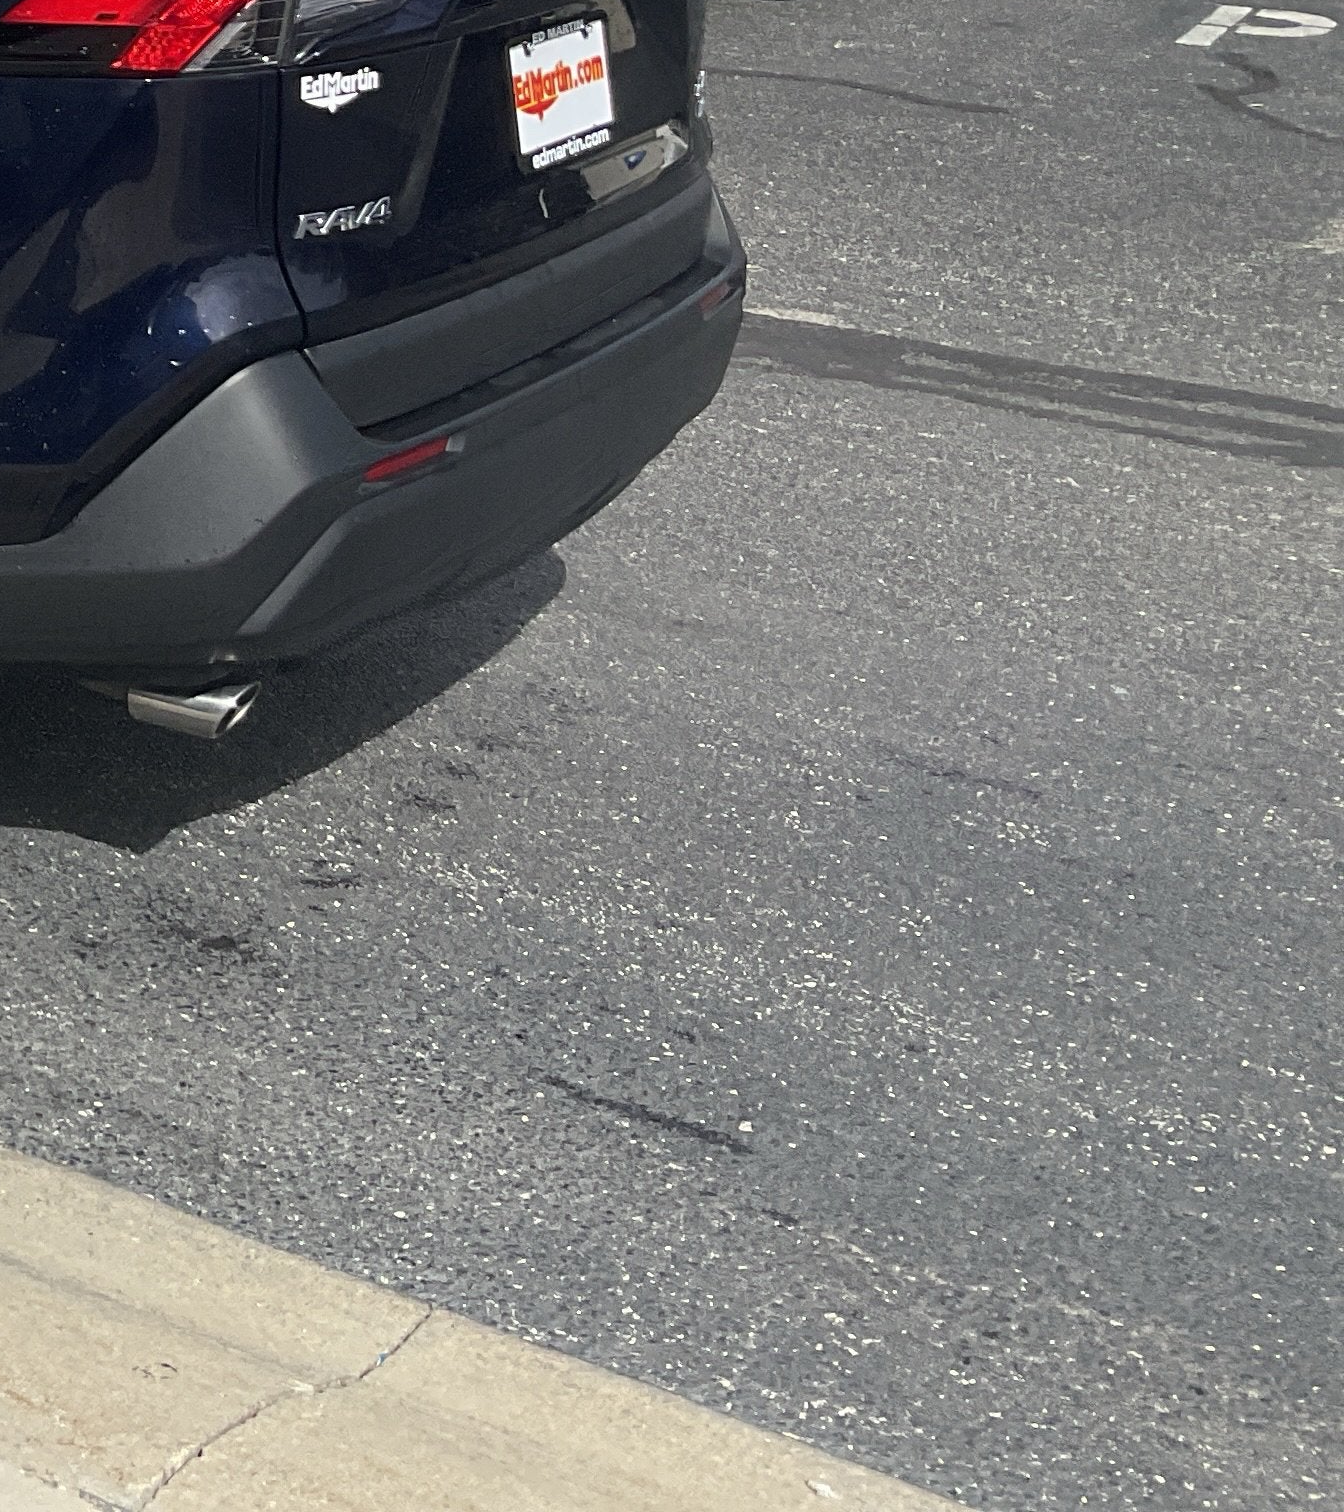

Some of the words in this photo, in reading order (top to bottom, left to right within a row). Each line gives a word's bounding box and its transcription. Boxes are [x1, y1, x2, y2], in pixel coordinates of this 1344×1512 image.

[531, 31, 545, 45] ED
[547, 19, 585, 38] MARTIN
[532, 128, 610, 169] edmartin.com
[294, 196, 392, 239] RAV4
